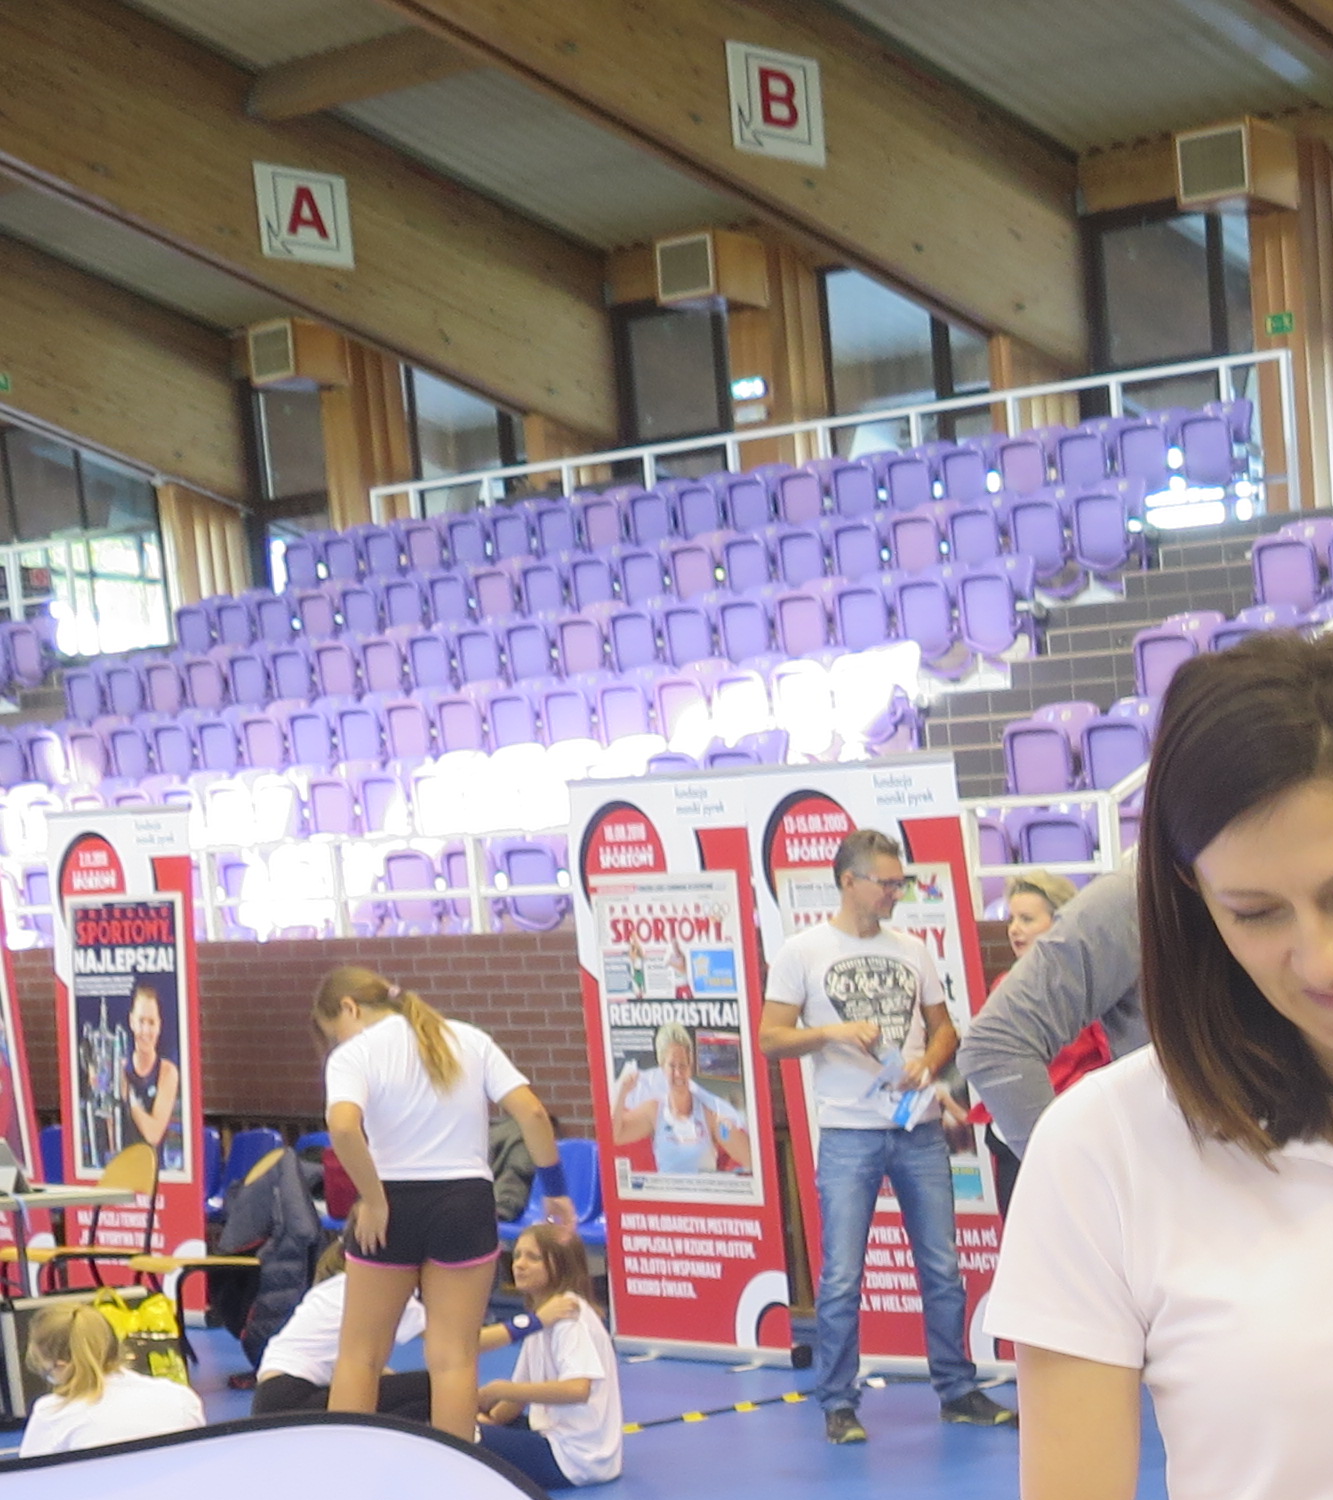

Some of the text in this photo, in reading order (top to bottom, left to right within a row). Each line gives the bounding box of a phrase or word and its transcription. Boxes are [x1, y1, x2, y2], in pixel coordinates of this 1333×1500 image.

[757, 66, 800, 130] B
[287, 186, 330, 240] A
[609, 917, 723, 945] SPORTOWY
[74, 947, 175, 974] NAJLEPSZA!
[608, 1001, 739, 1028] REKORDZISTKA!
[881, 1294, 924, 1313] HELSIN
